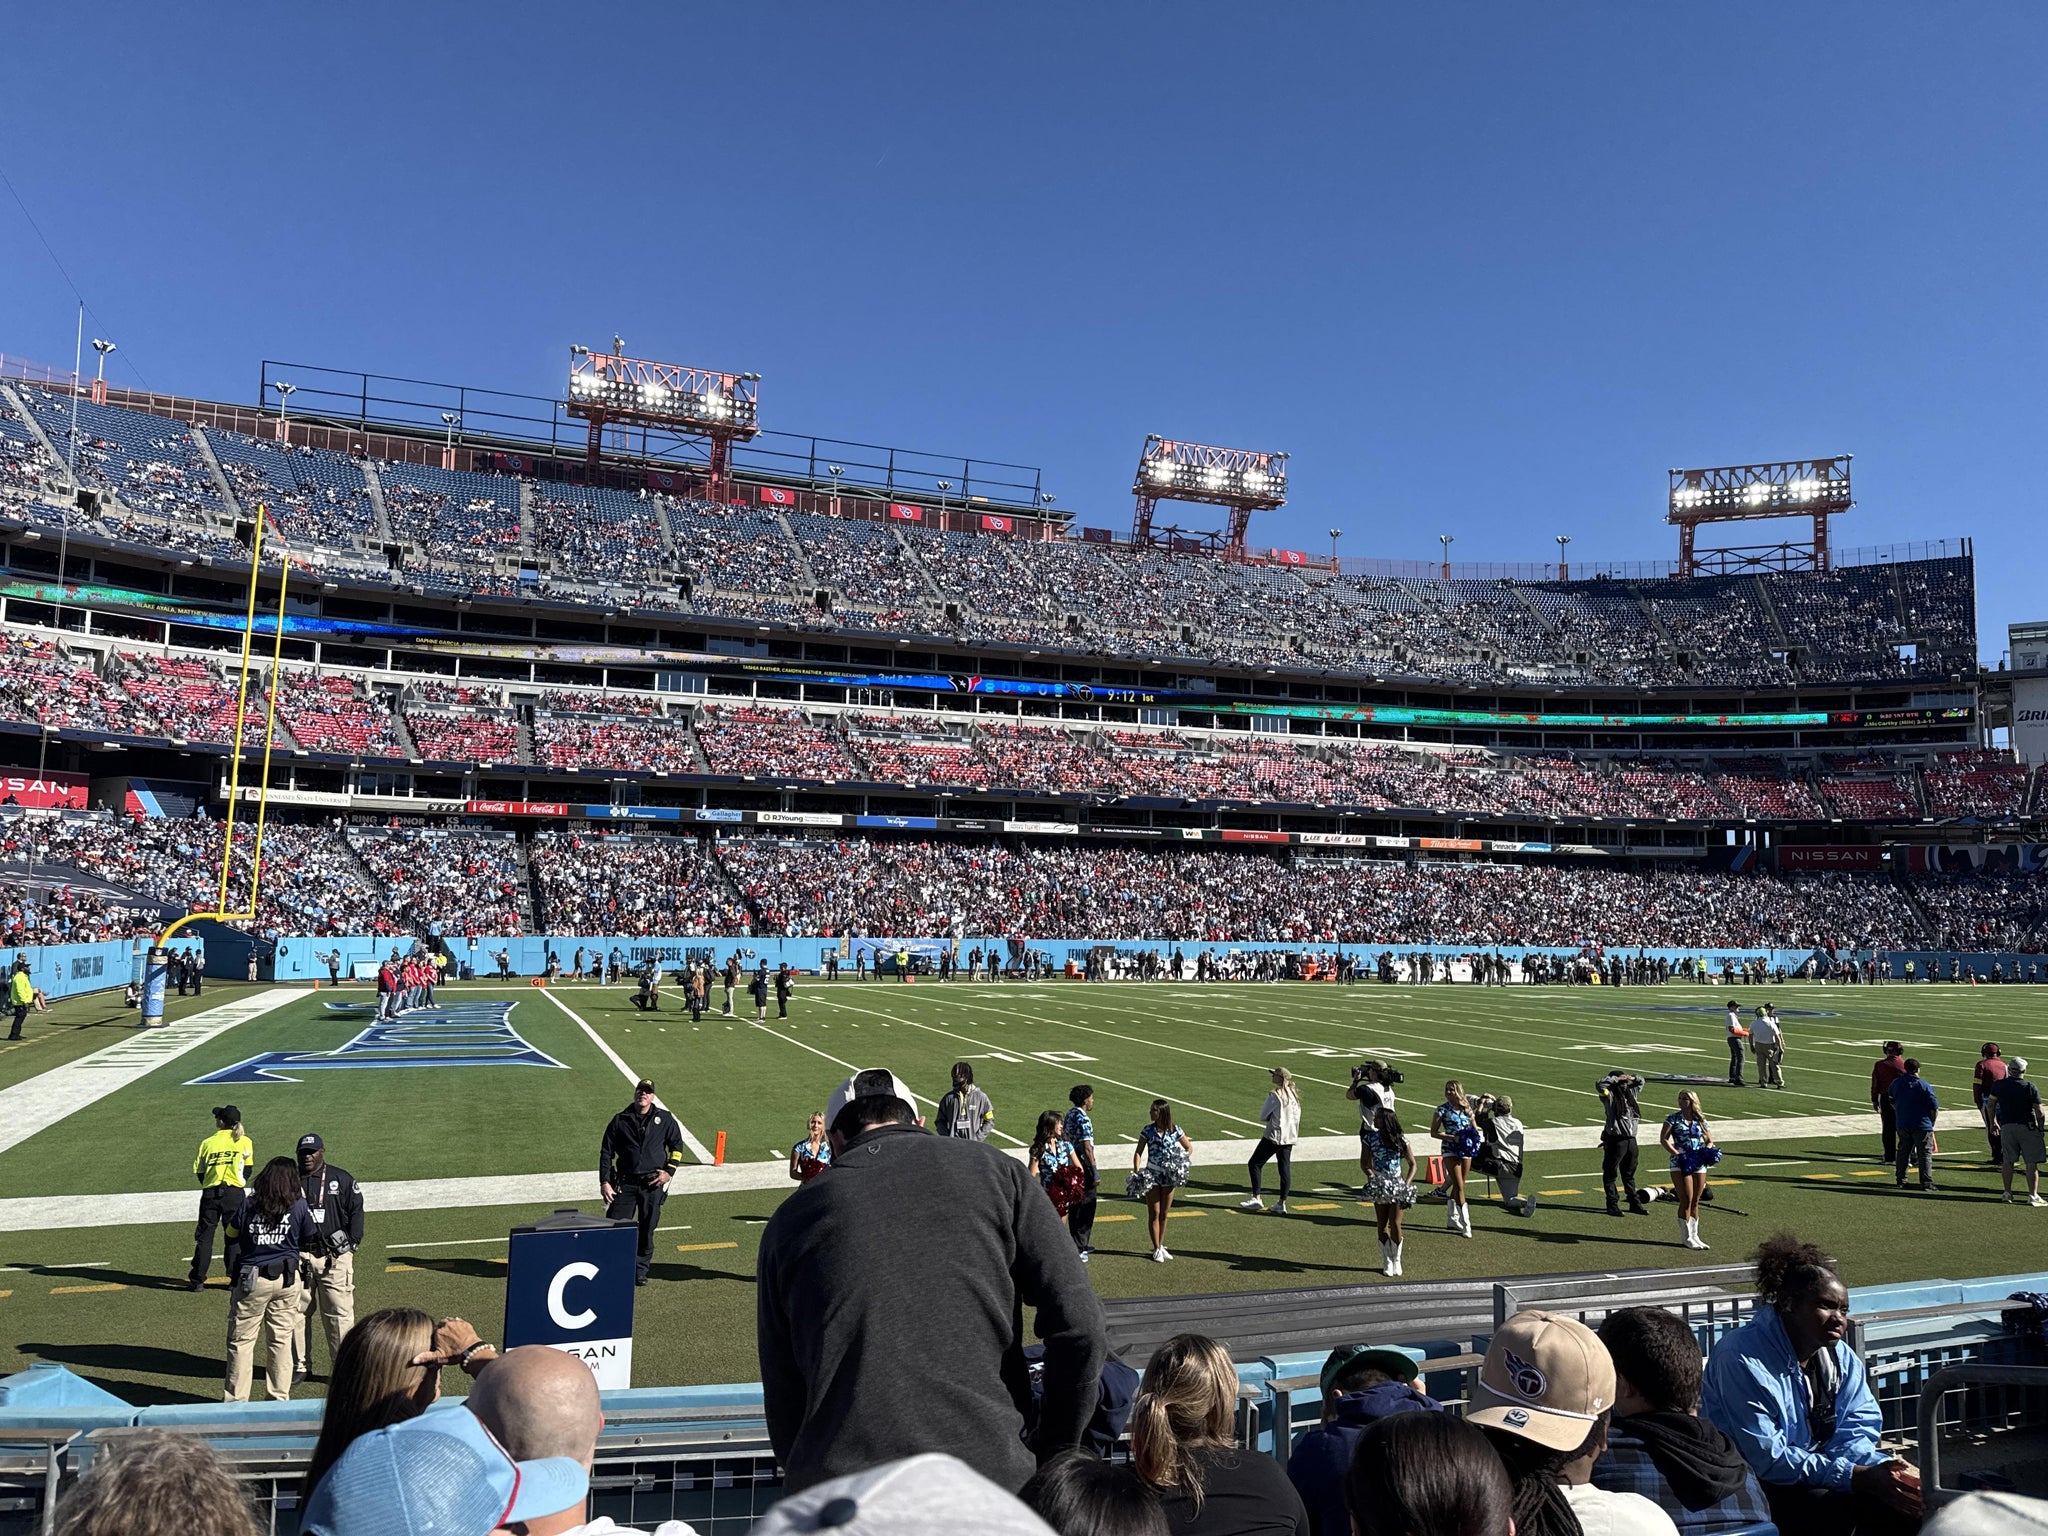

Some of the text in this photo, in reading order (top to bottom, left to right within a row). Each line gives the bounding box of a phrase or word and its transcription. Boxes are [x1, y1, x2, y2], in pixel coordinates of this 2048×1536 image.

[177, 608, 208, 617] MATTHEW
[877, 673, 896, 683] 3rd
[905, 675, 913, 683] 7
[1107, 689, 1155, 703] 9:12 1st
[2017, 710, 2048, 722] BRI
[264, 793, 296, 801] ENNESSEE
[479, 802, 506, 812] Coca-Cola
[529, 804, 556, 814] Coca-Cola
[351, 814, 378, 824] RING
[711, 810, 741, 819] Gallagher
[567, 820, 592, 829] MIKE
[633, 823, 649, 831] JIM
[737, 826, 755, 834] KEN
[803, 828, 835, 836] GEORGE
[1791, 851, 1868, 860] NISSAN
[208, 1150, 240, 1160] BEST
[546, 1261, 600, 1330] C
